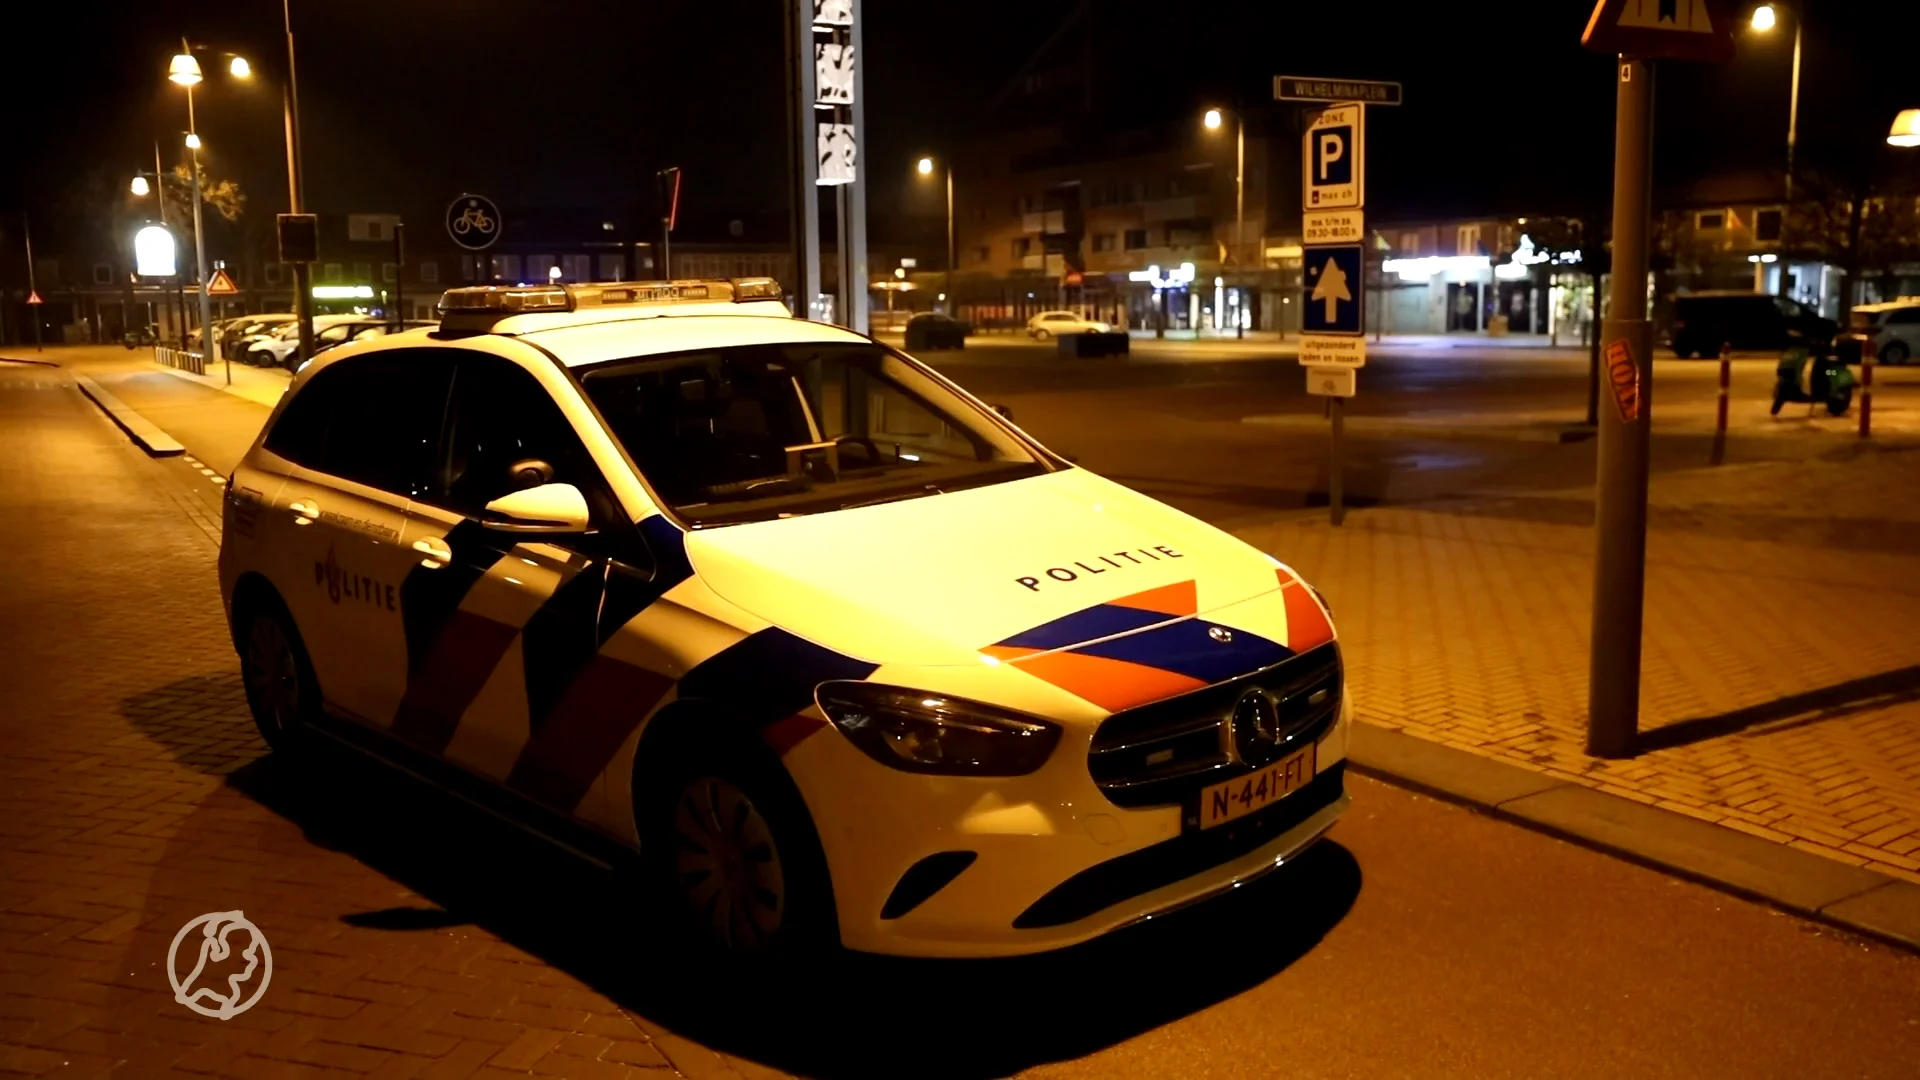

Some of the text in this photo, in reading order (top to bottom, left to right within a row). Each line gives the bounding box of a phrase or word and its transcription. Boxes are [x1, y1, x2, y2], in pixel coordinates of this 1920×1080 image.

[1294, 82, 1387, 99] WILHELMINAPLEIN
[1318, 112, 1344, 125] ZONE
[1321, 134, 1343, 179] P
[315, 551, 395, 611] POLITIE
[1015, 545, 1183, 592] POLITIE
[1212, 754, 1304, 820] N-441-FT
